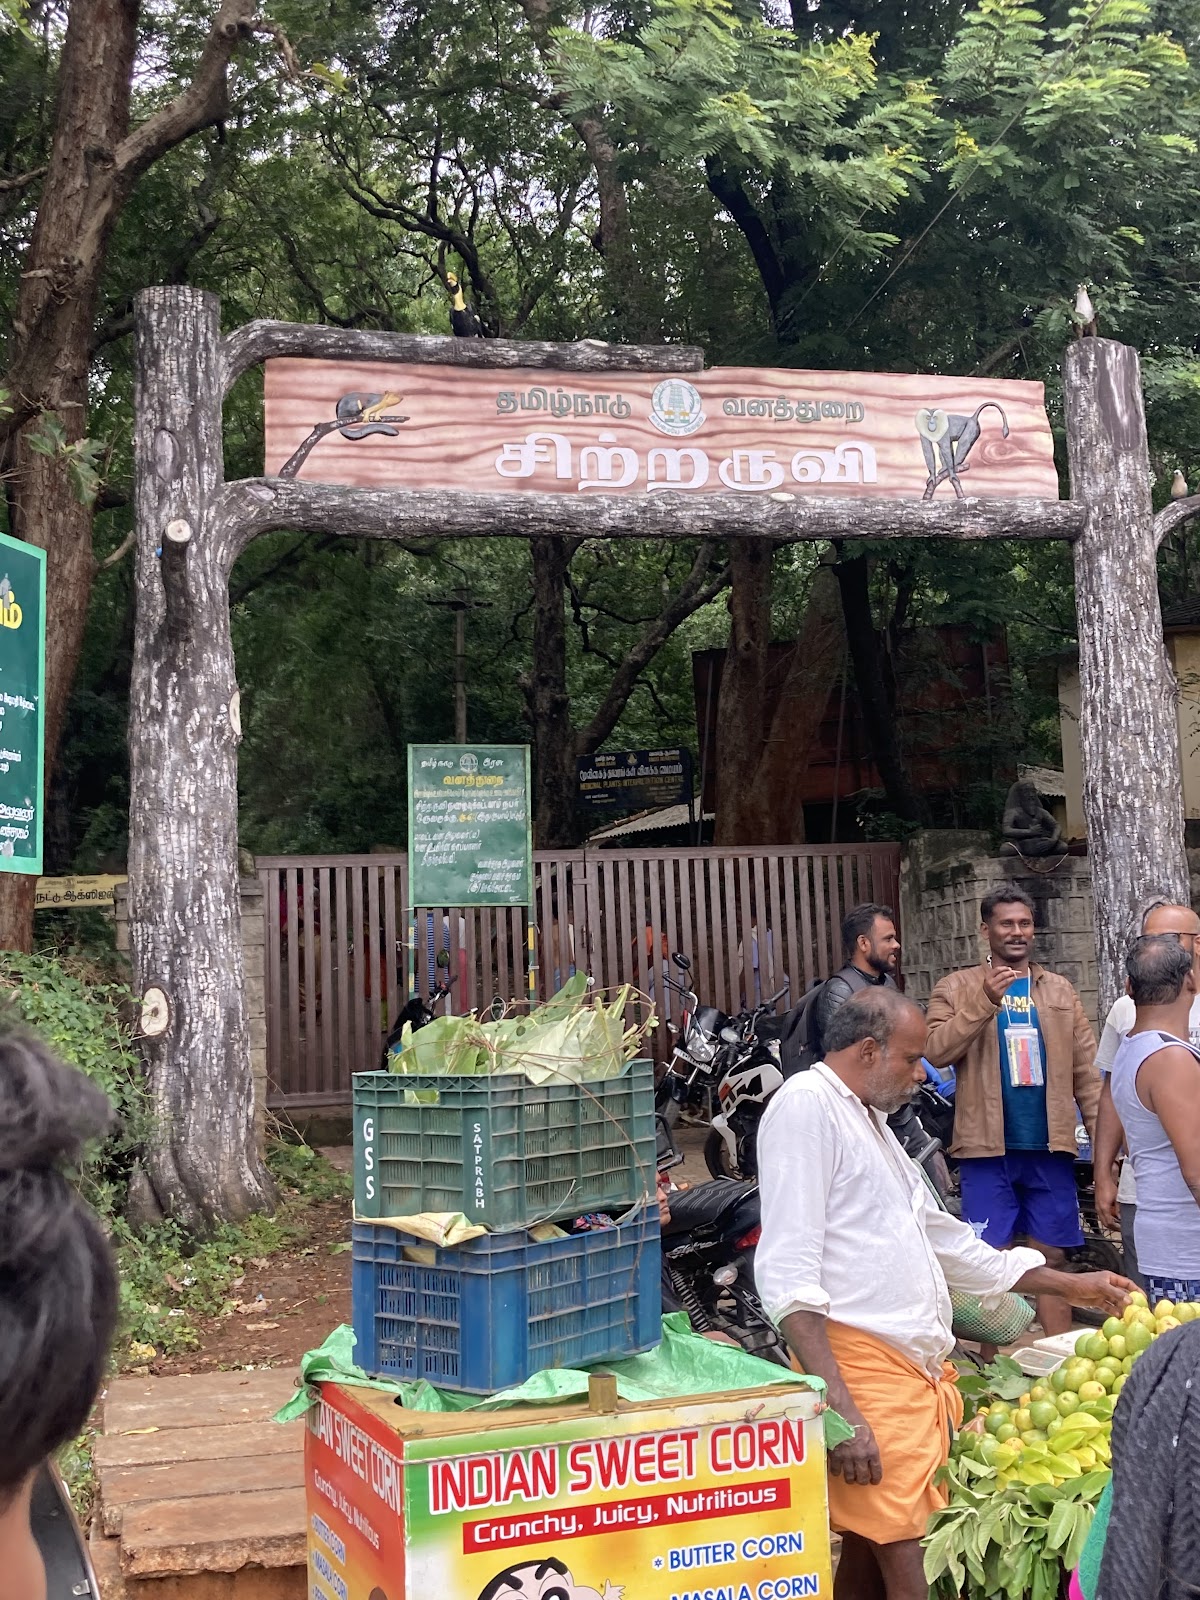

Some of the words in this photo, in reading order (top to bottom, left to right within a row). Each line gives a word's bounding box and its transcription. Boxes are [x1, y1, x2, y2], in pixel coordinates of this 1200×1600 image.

[496, 387, 632, 419] தமிழ்நாடு
[723, 397, 865, 424] வனத்துறை
[495, 432, 878, 493] சிற்றருவி
[335, 1413, 369, 1484] SWEET
[371, 1443, 401, 1516] CORN
[430, 1448, 557, 1513] INDIAN
[569, 1431, 699, 1493] SWEET
[710, 1418, 804, 1472] CORN
[353, 1506, 380, 1550] Nutritious
[473, 1513, 584, 1545] Crunchy,
[593, 1502, 659, 1527] Juicy,
[667, 1486, 777, 1516] Nutritious
[669, 1542, 735, 1569] BUTTER
[742, 1533, 802, 1558] CORN
[758, 1575, 817, 1600] CORN
